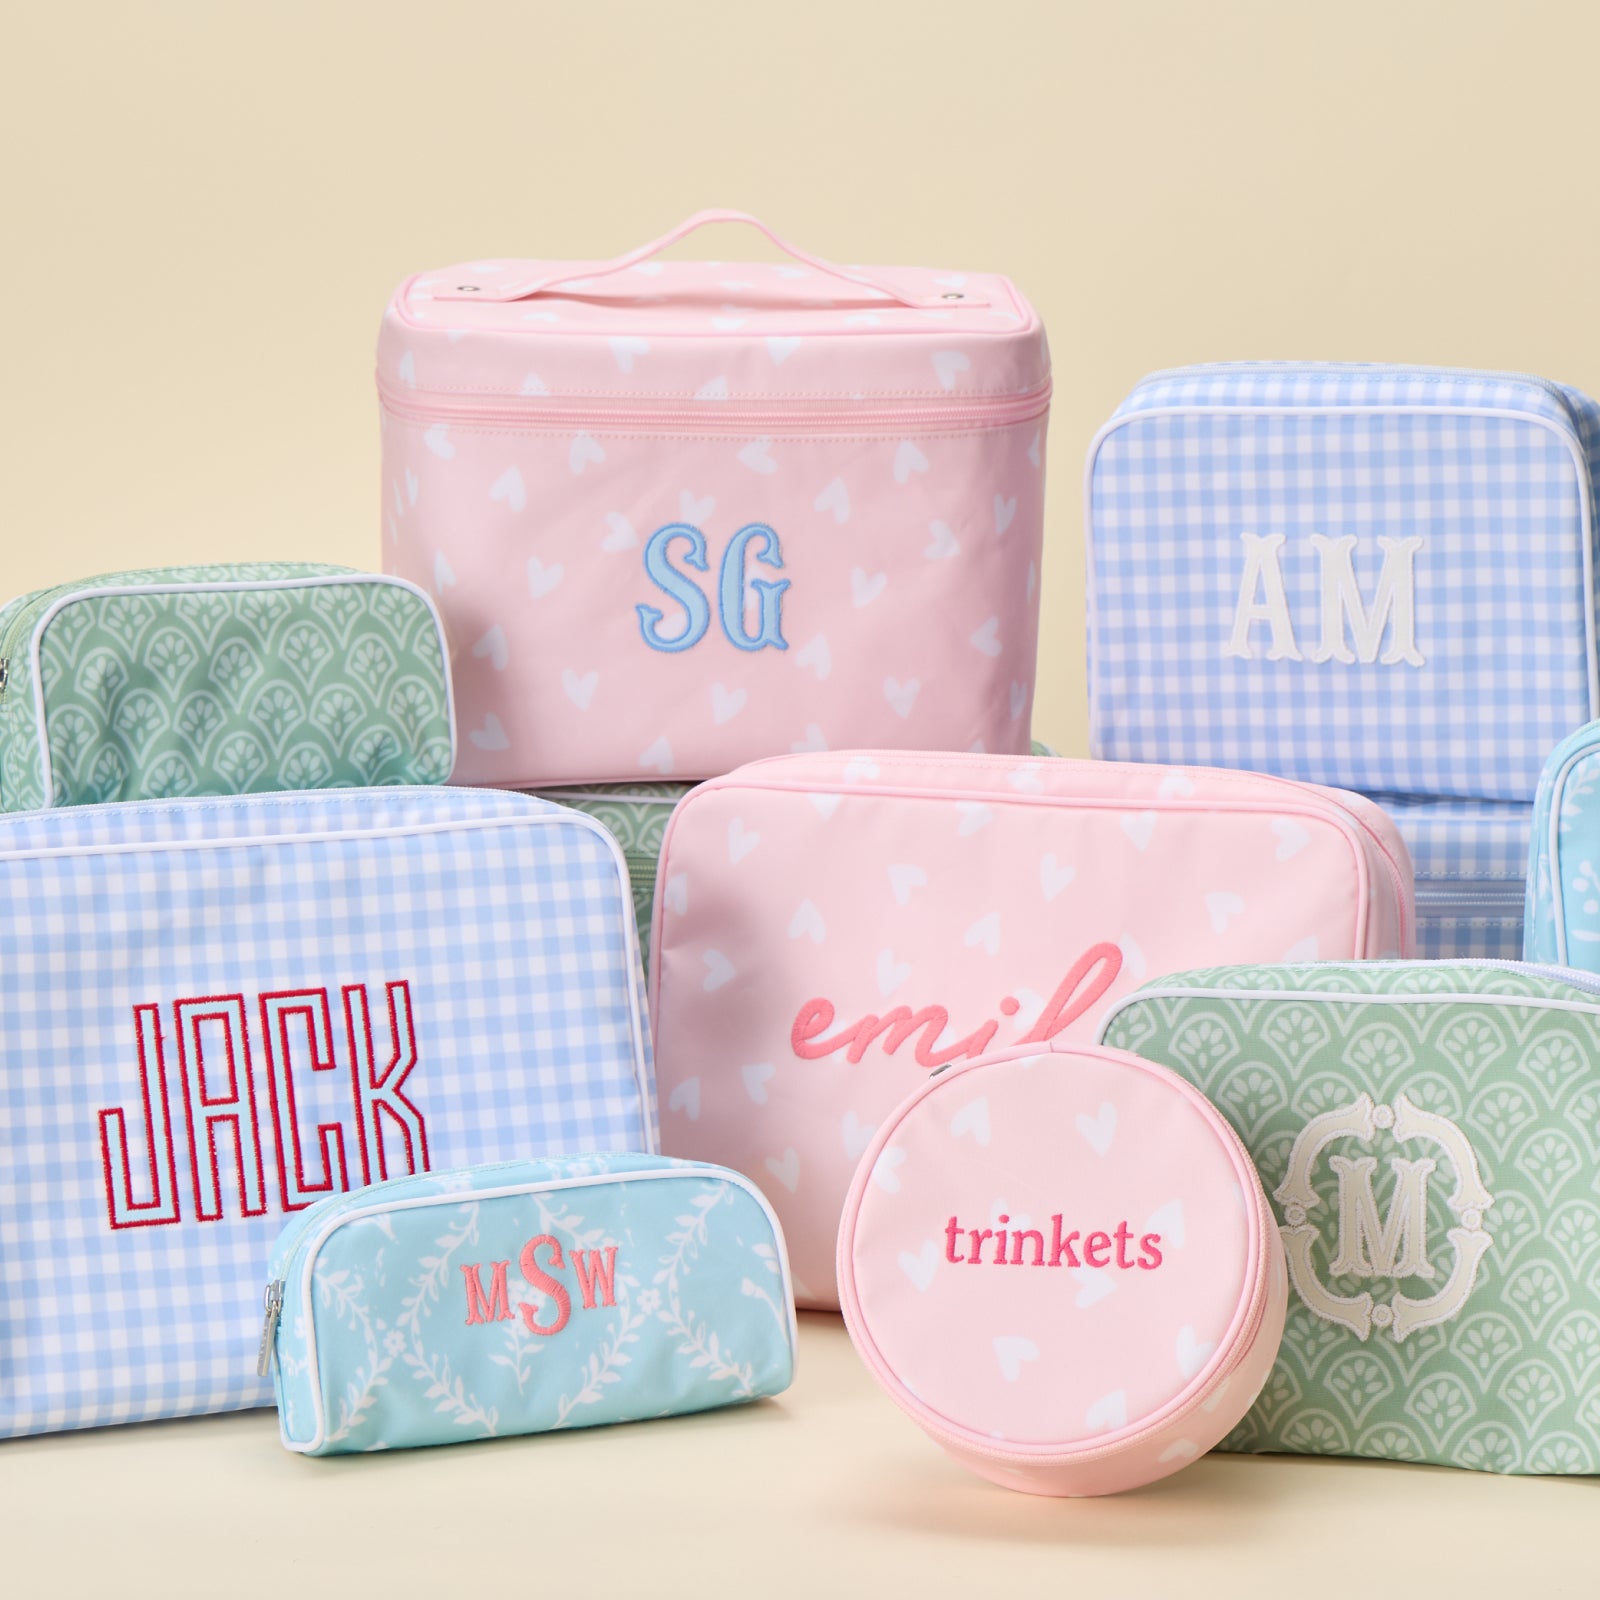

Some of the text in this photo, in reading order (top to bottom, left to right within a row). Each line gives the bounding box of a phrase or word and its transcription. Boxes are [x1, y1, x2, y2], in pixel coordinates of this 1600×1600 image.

[636, 523, 791, 652] SG
[1222, 533, 1425, 666] AM
[98, 980, 430, 1229] JACK
[945, 1214, 1163, 1269] trinkets
[1330, 1157, 1435, 1278] M
[460, 1235, 618, 1335] MSW
